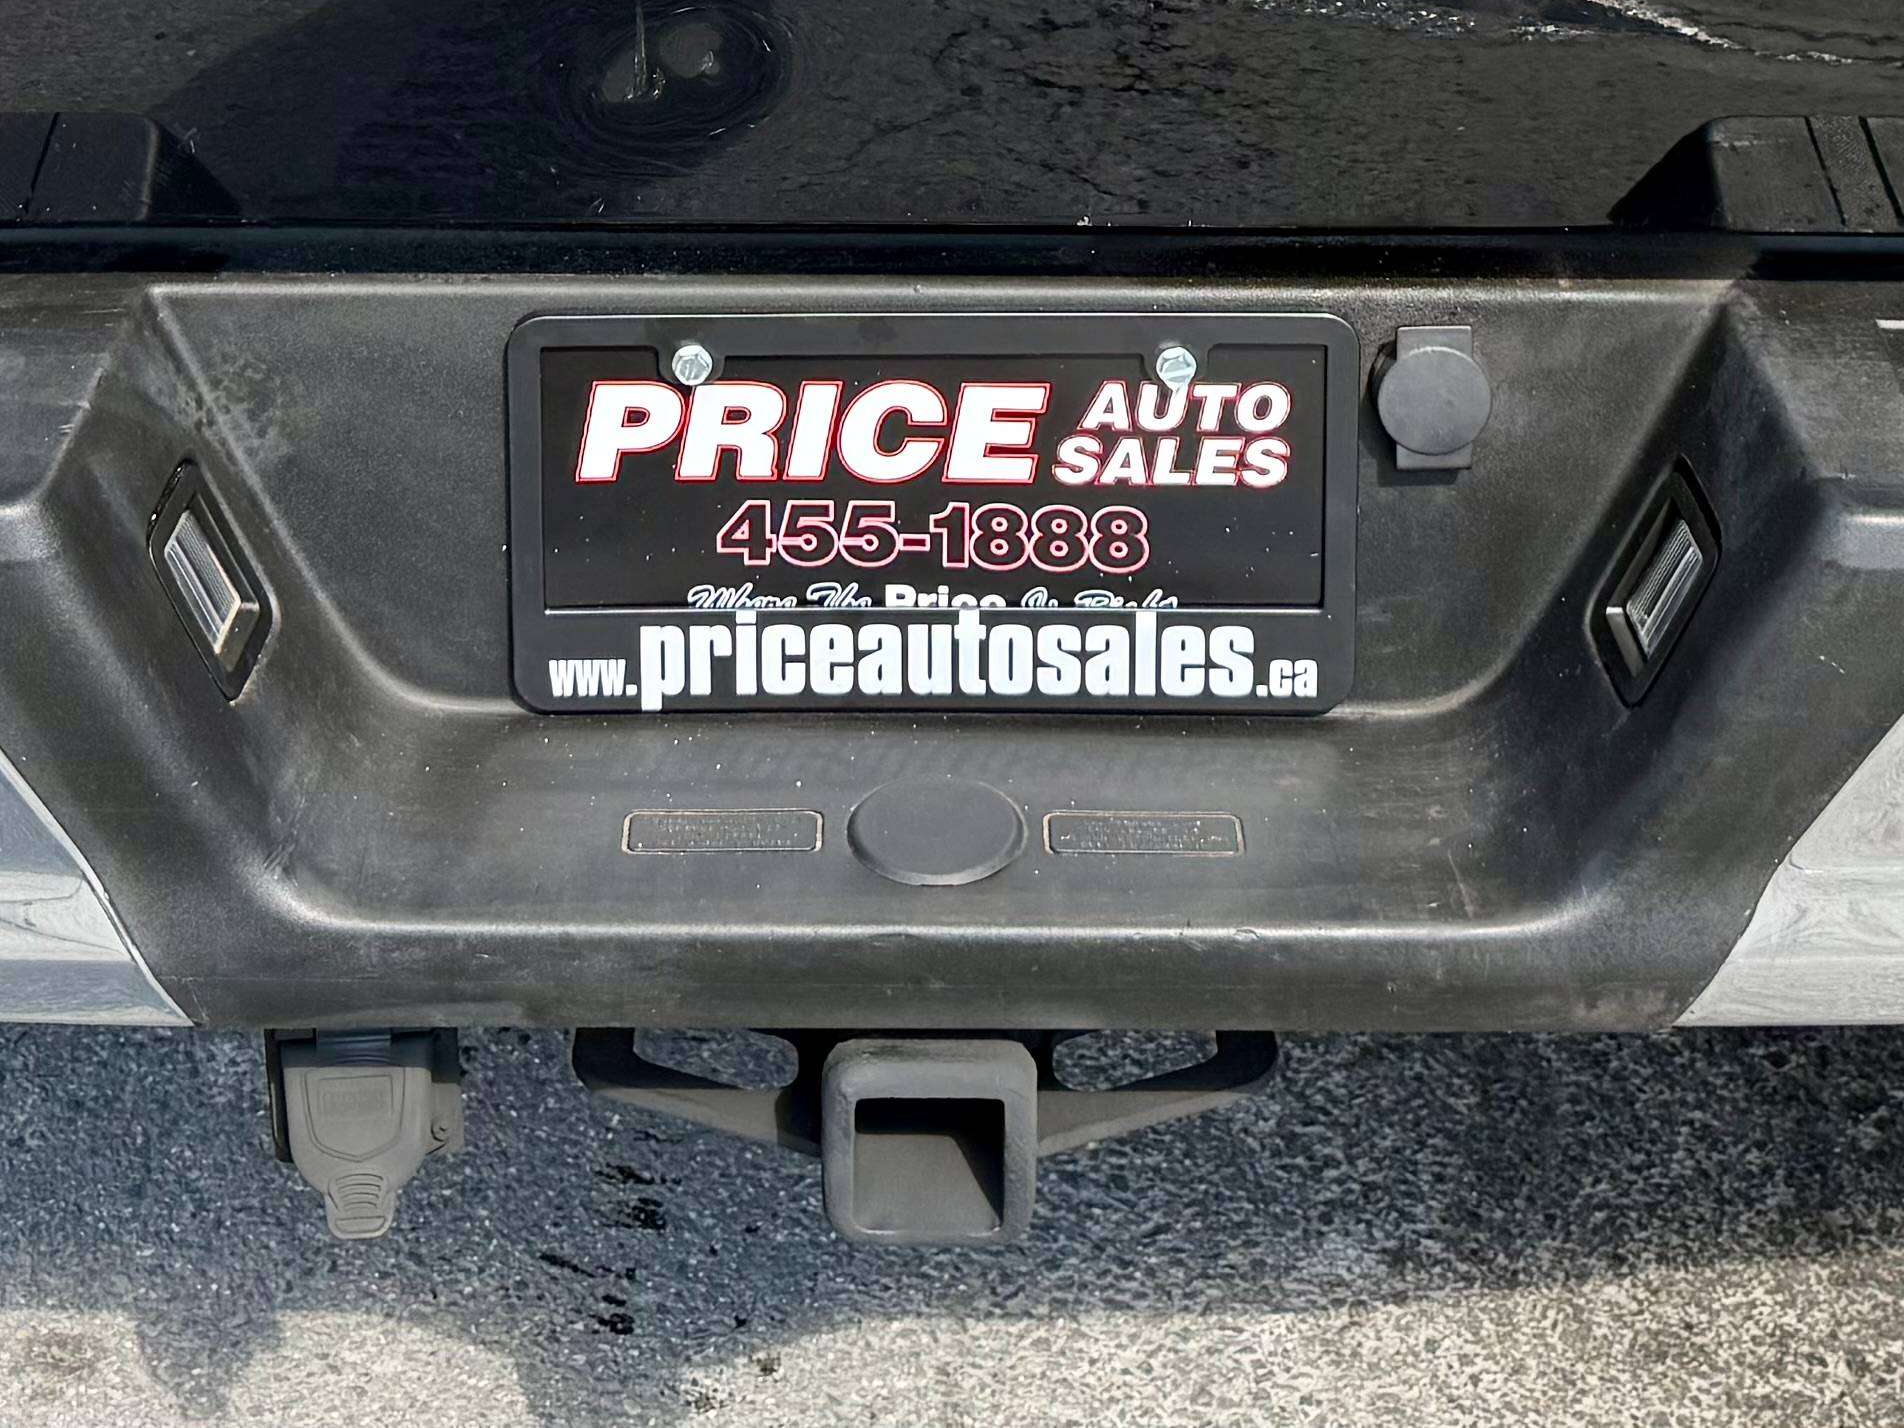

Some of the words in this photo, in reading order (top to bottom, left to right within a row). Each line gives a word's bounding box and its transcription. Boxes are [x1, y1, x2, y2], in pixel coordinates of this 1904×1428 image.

[574, 380, 1050, 485] PRICE
[1079, 380, 1290, 432] AUTO
[1051, 435, 1289, 488] SALES
[716, 499, 1150, 573] 455-1888
[548, 608, 1319, 712] www.priceautosales.ca
